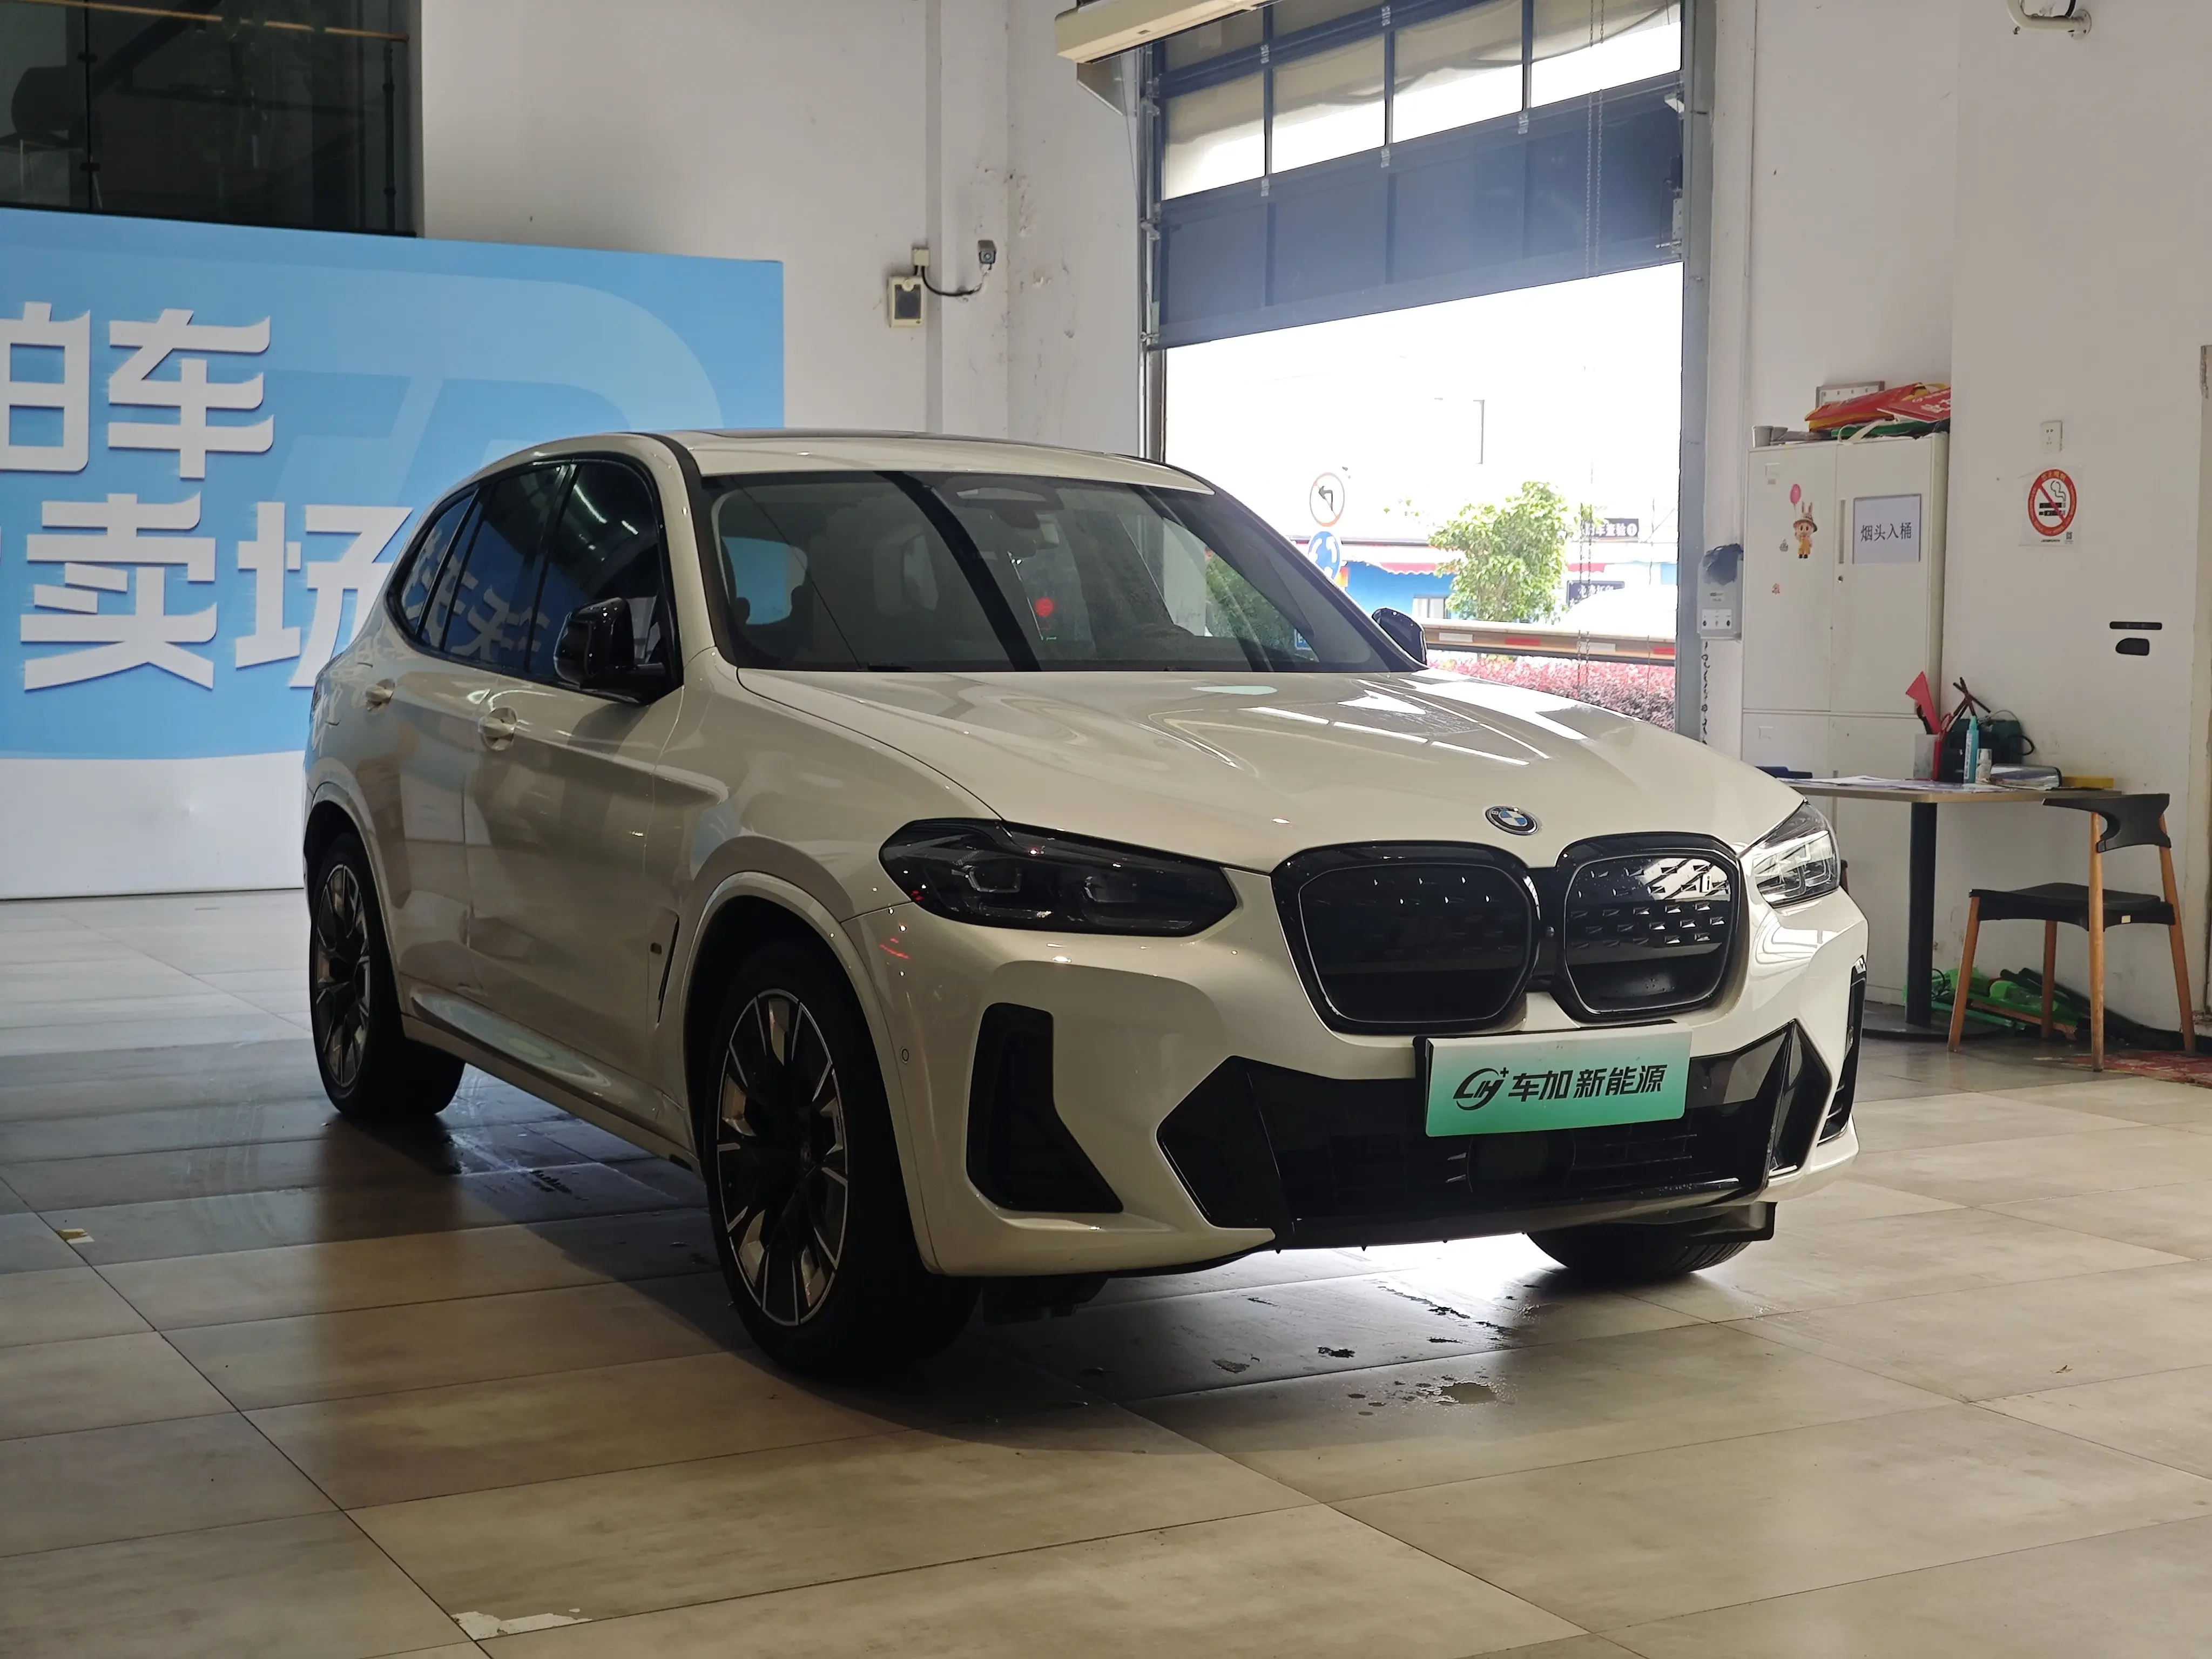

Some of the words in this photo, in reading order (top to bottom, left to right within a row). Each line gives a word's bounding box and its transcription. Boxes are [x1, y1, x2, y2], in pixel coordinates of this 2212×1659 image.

[1860, 522, 1912, 542] 烟头入桶
[1508, 1064, 1668, 1102] 车加新能源
